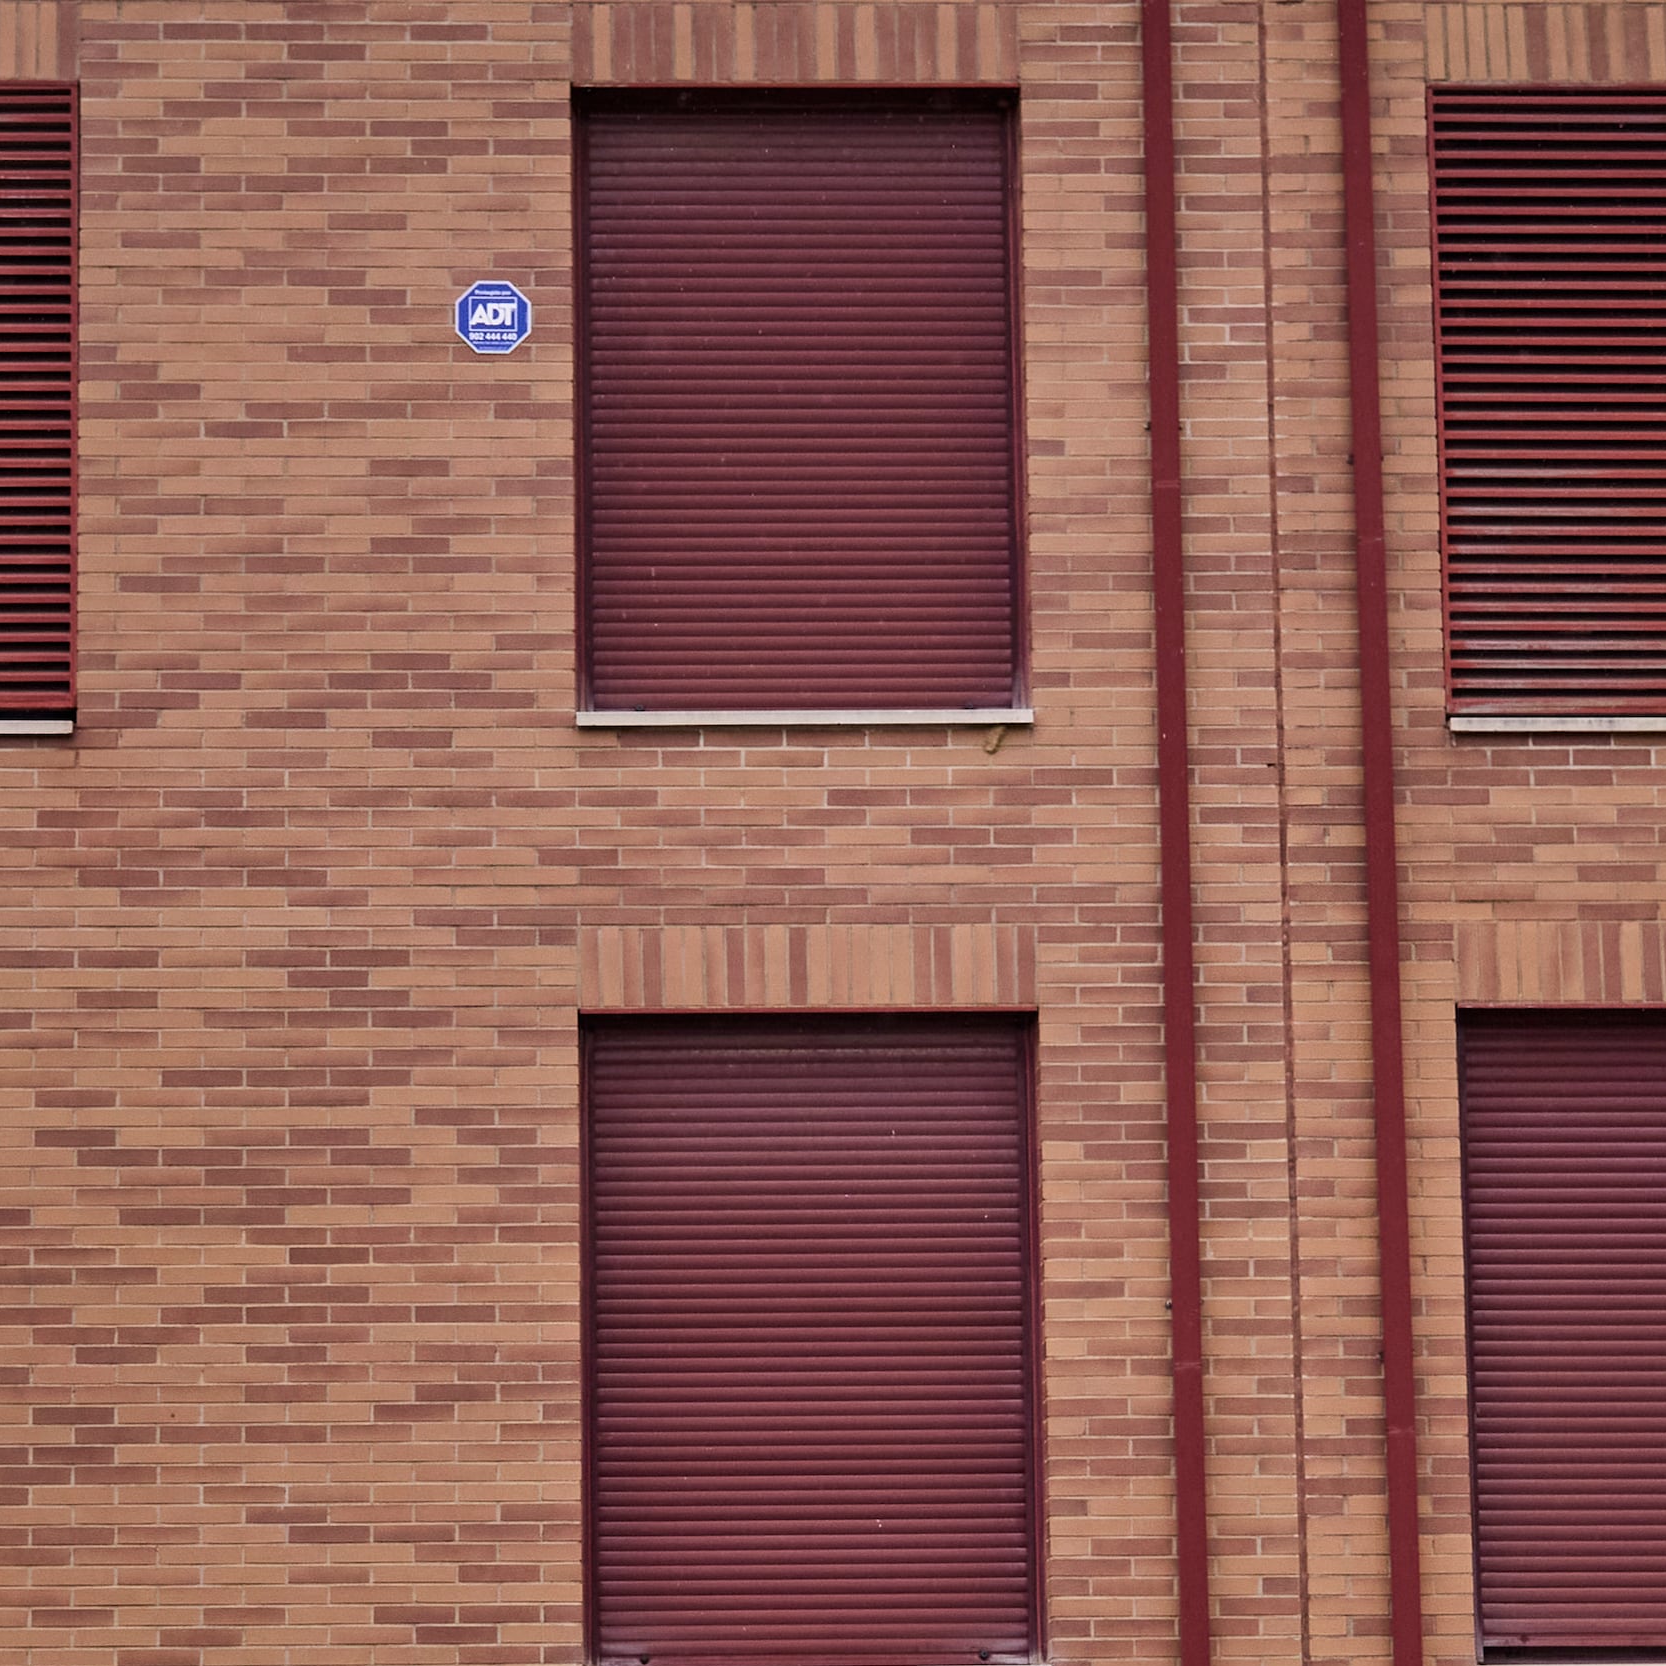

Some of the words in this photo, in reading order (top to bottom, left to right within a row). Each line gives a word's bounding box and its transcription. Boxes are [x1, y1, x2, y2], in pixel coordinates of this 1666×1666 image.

[470, 303, 517, 326] ADT
[469, 332, 485, 340] 902
[485, 332, 501, 340] 444
